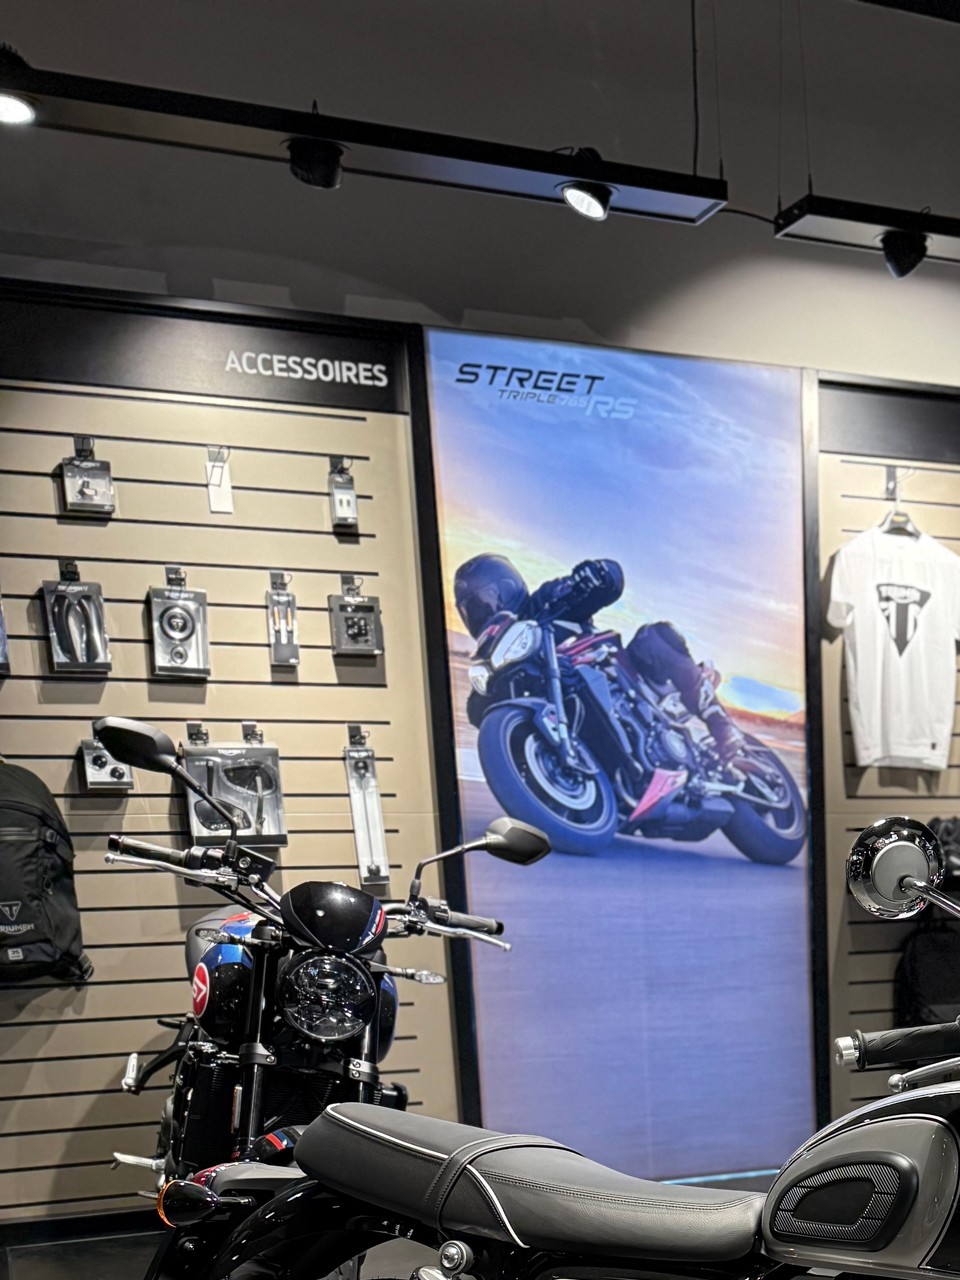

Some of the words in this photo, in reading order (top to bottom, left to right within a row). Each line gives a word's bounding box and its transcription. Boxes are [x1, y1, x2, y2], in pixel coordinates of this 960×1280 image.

[225, 350, 388, 387] ACCESSOIRES
[455, 363, 605, 395] STREET
[498, 389, 558, 405] TRIPLE
[585, 394, 638, 420] RS
[0, 922, 35, 934] RIUMPH
